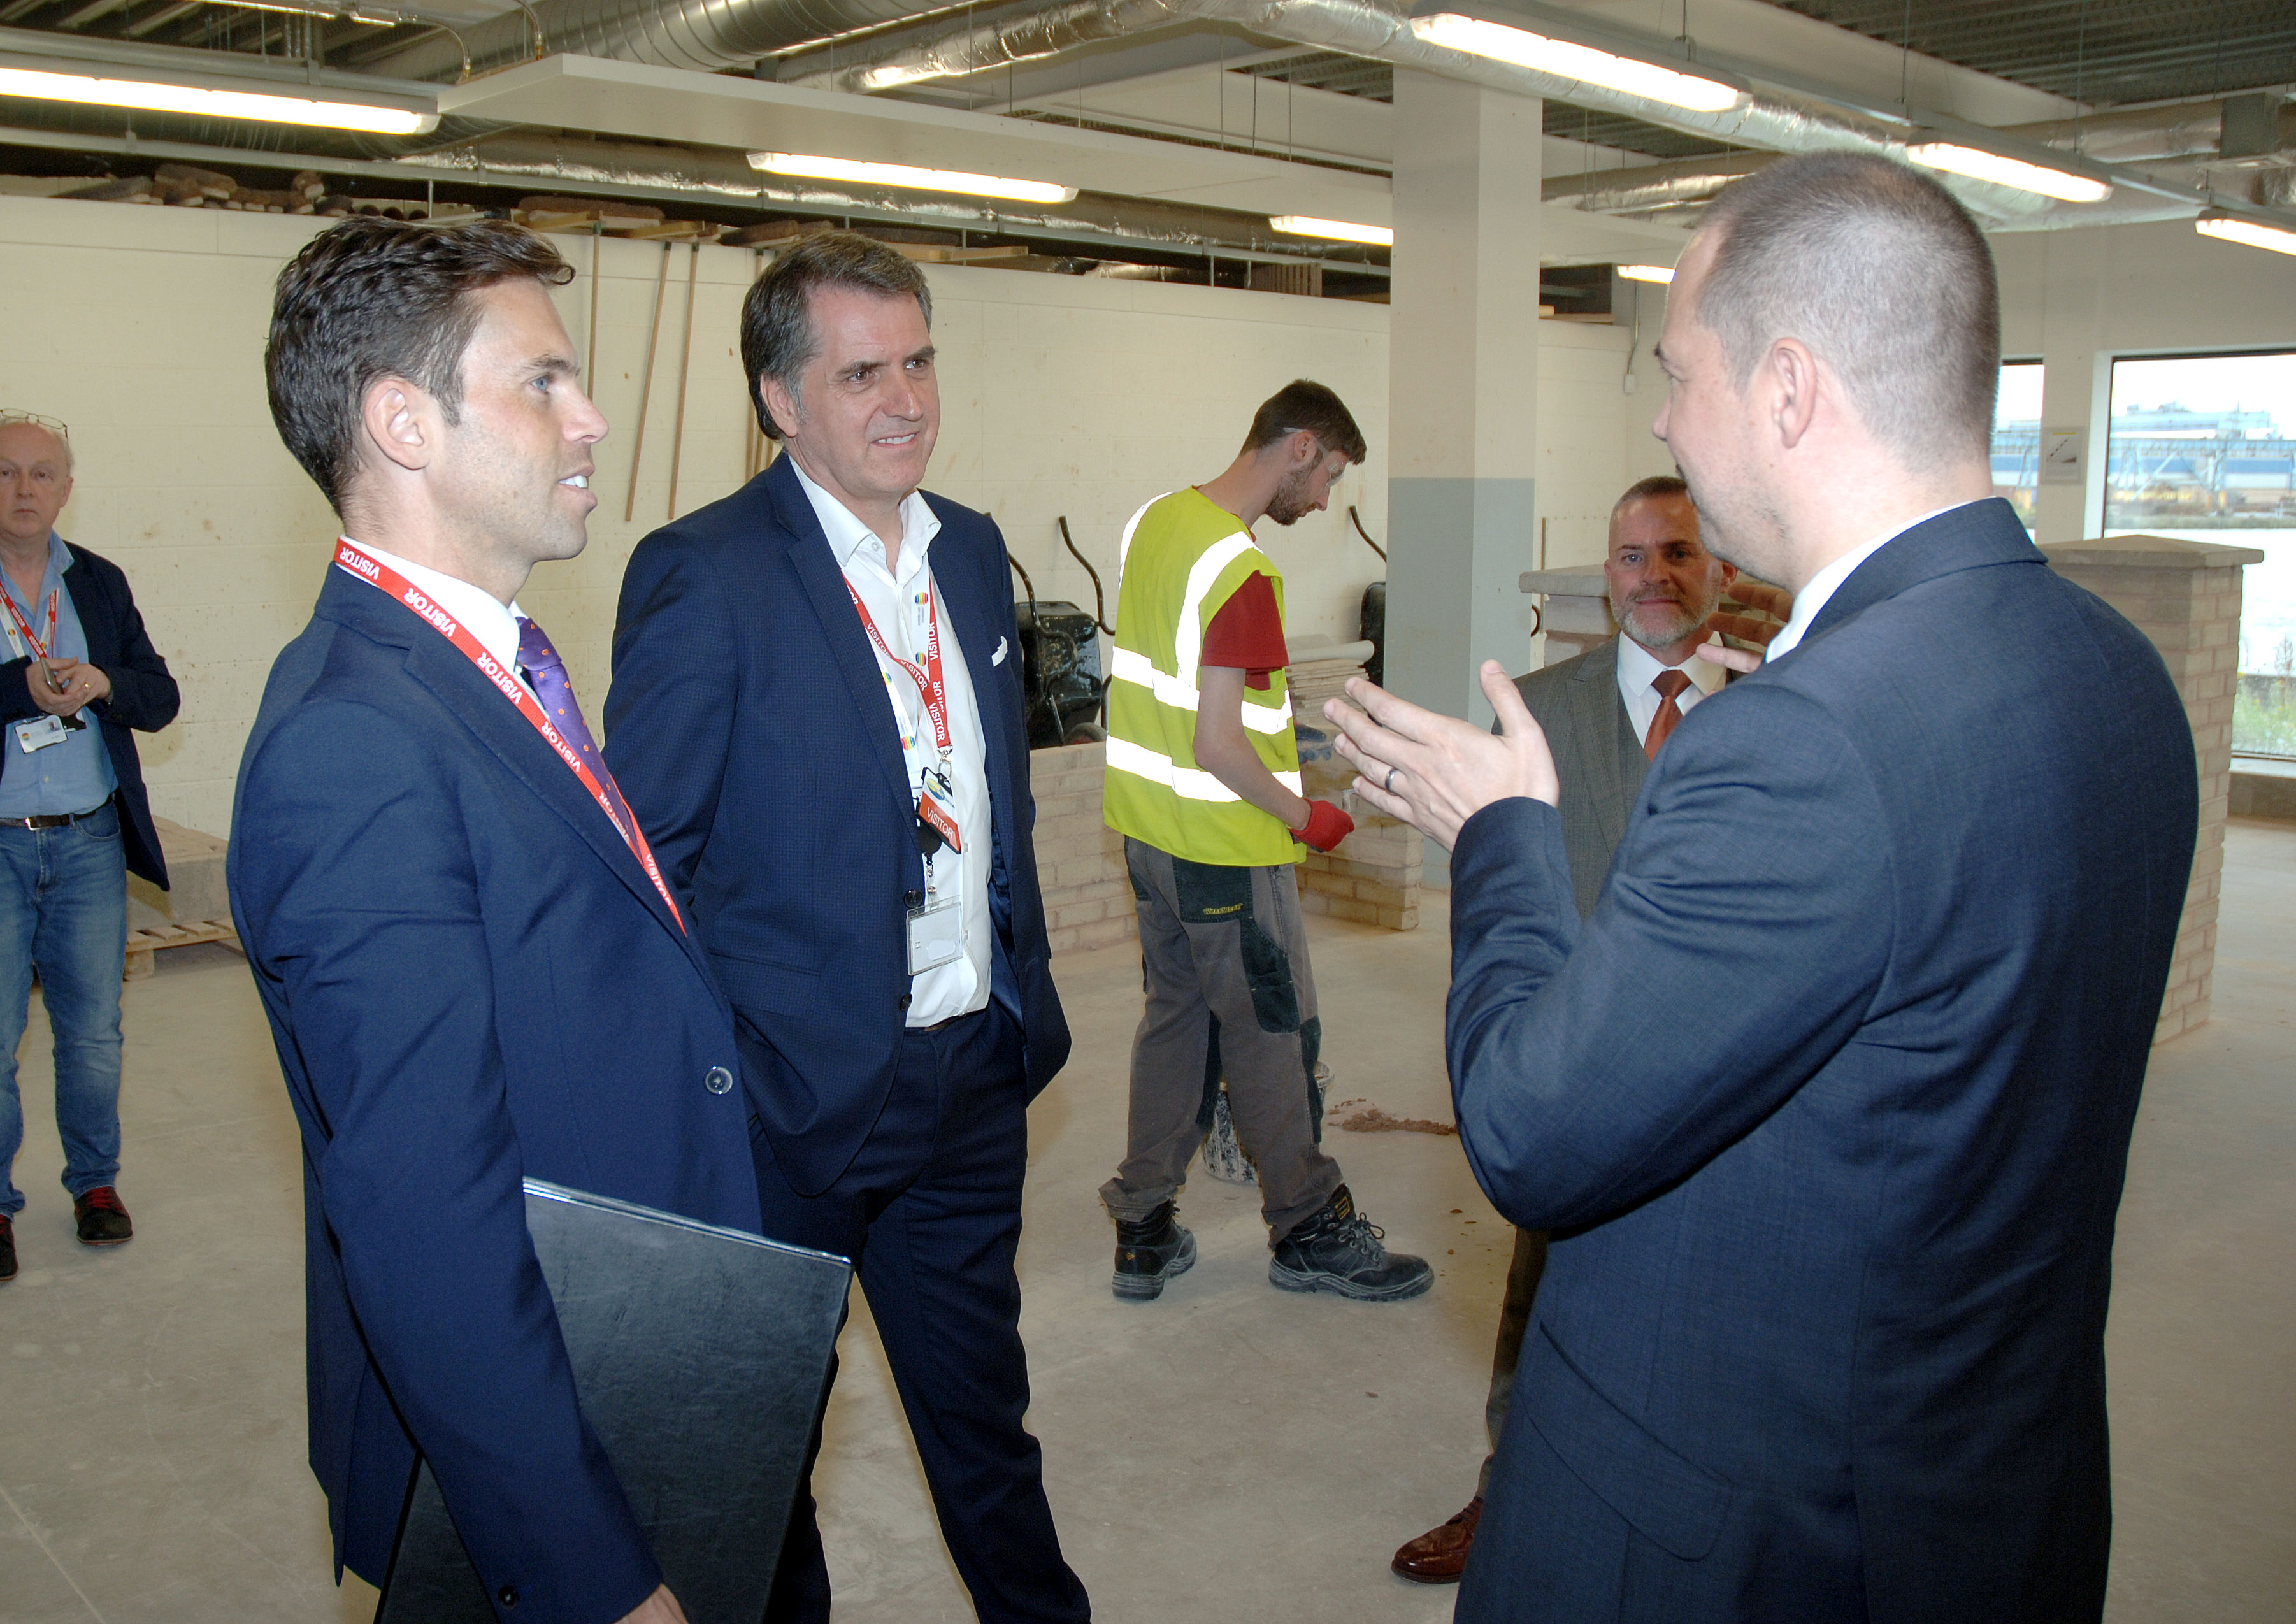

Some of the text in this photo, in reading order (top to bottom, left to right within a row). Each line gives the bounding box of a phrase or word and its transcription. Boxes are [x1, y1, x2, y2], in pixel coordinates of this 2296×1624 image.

[340, 547, 380, 580] VISITOR
[404, 587, 456, 637] VISITOR
[929, 622, 939, 661] VISITOR
[477, 652, 522, 704] VISITOR
[928, 702, 945, 741] VISITOR
[541, 721, 581, 772] VISITOR
[928, 807, 954, 839] VISITOR
